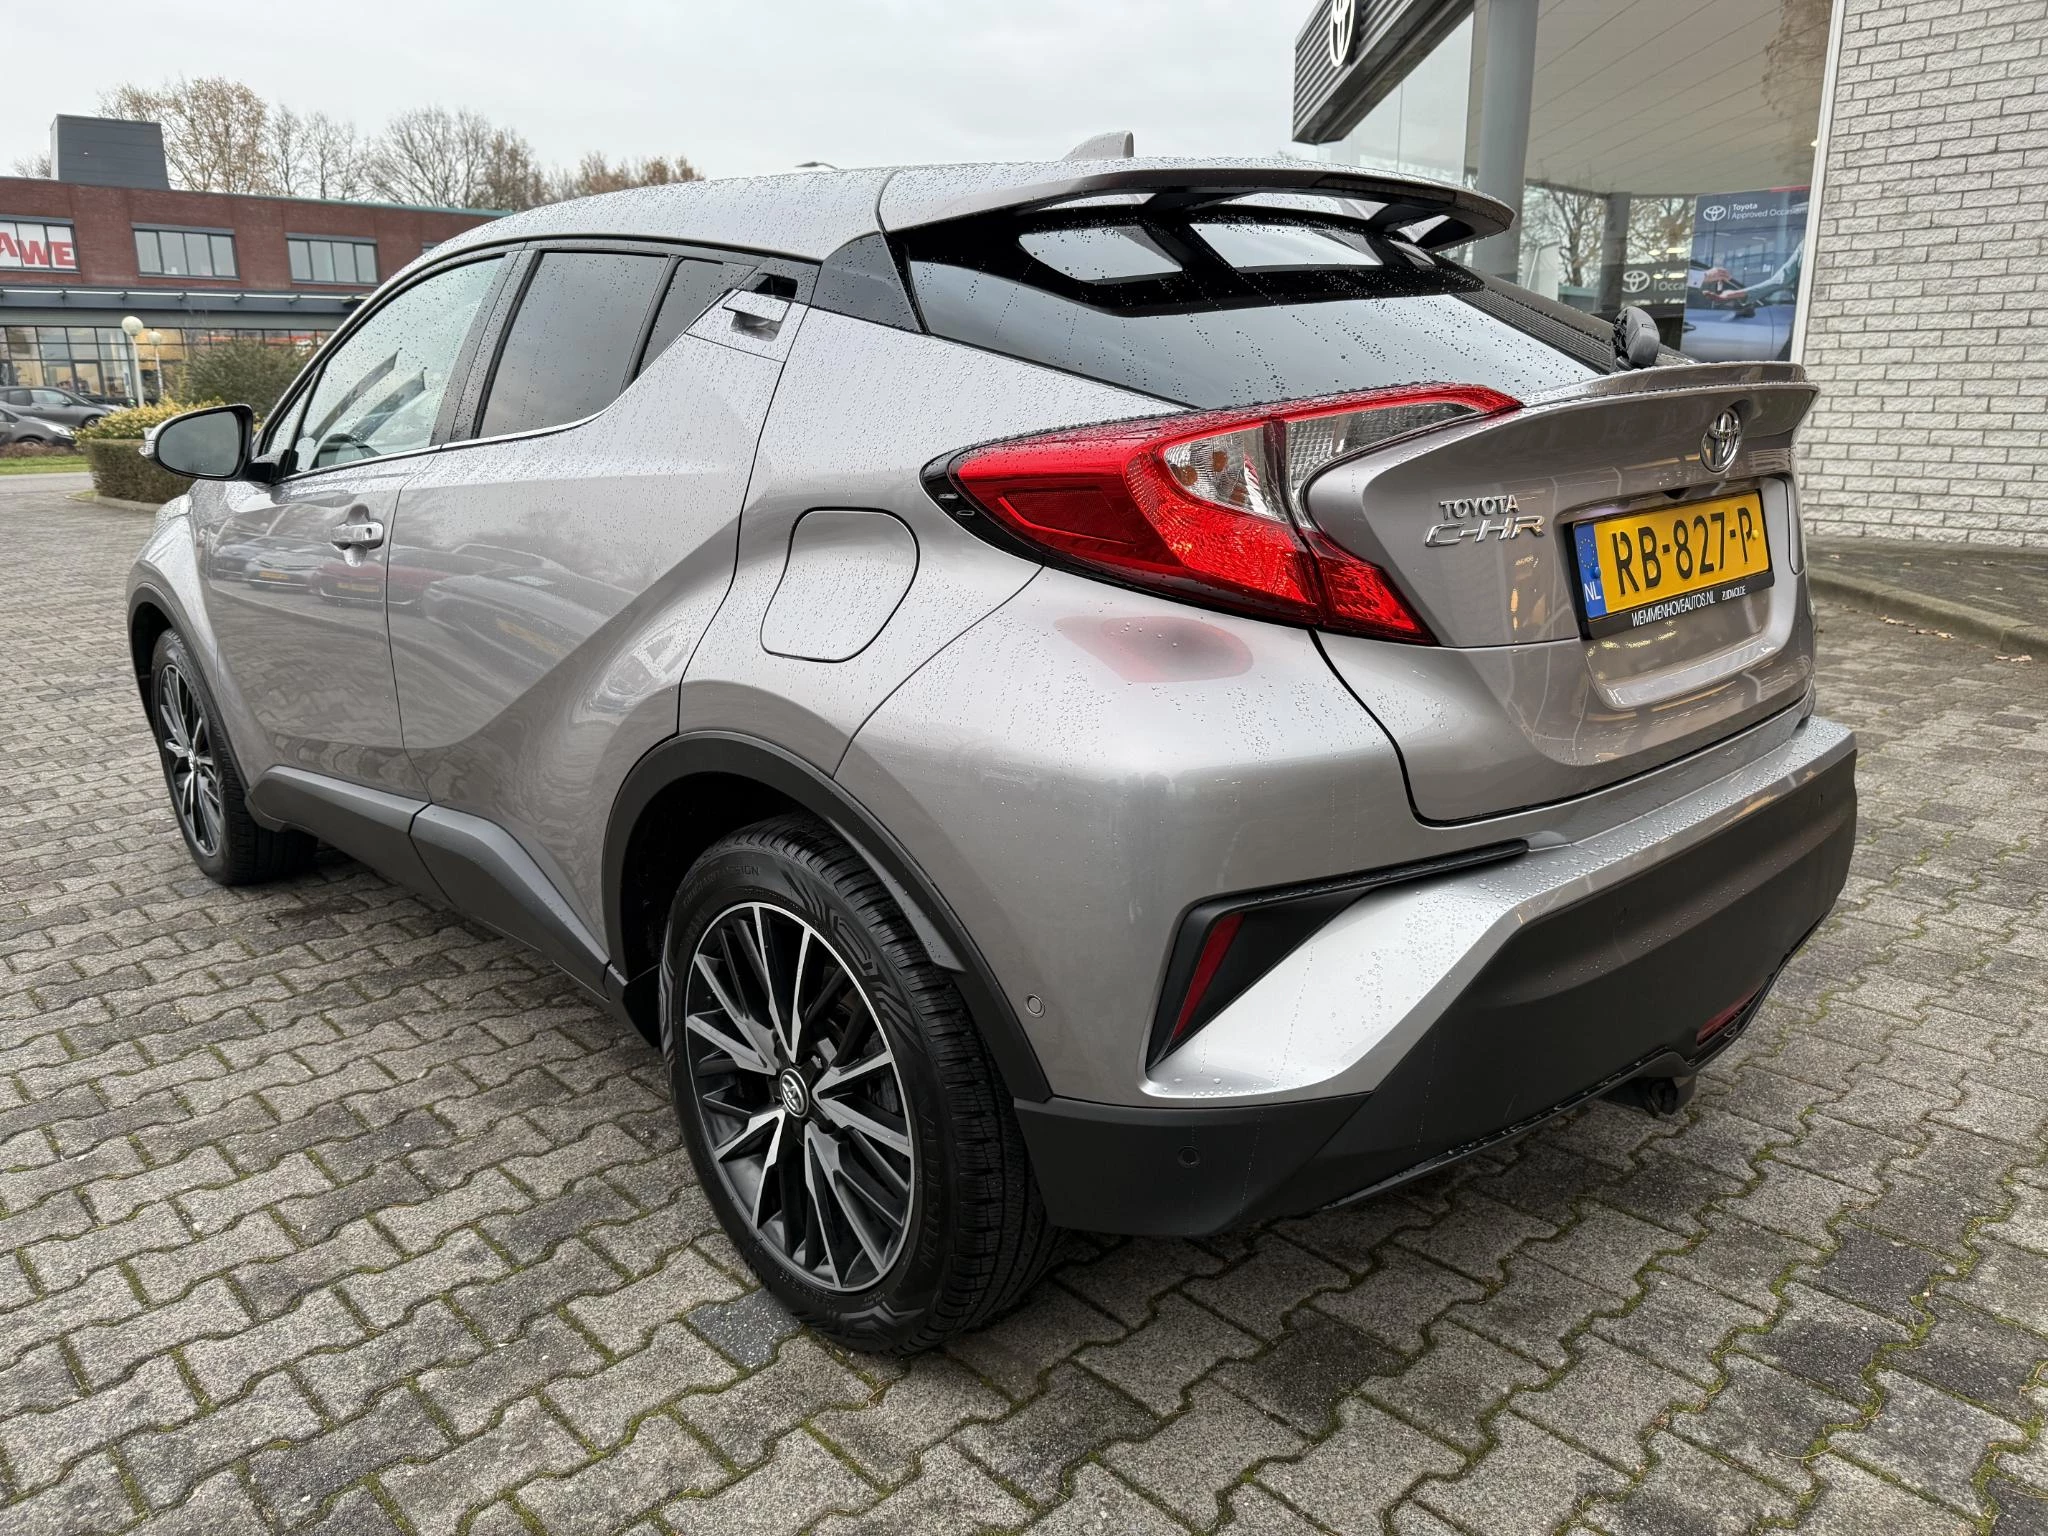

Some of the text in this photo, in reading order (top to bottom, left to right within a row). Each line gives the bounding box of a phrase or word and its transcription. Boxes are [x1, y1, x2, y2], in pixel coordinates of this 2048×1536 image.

[1731, 209, 1768, 220] Approved
[1733, 203, 1758, 212] Toyota
[1440, 494, 1520, 520] TOYOTA
[1424, 515, 1545, 547] C-HR
[1611, 507, 1753, 596] RB-827-P
[1584, 583, 1602, 602] NL
[1631, 585, 1747, 627] WEMMENHOVEAUTOS.NL ZUIDWOLDE
